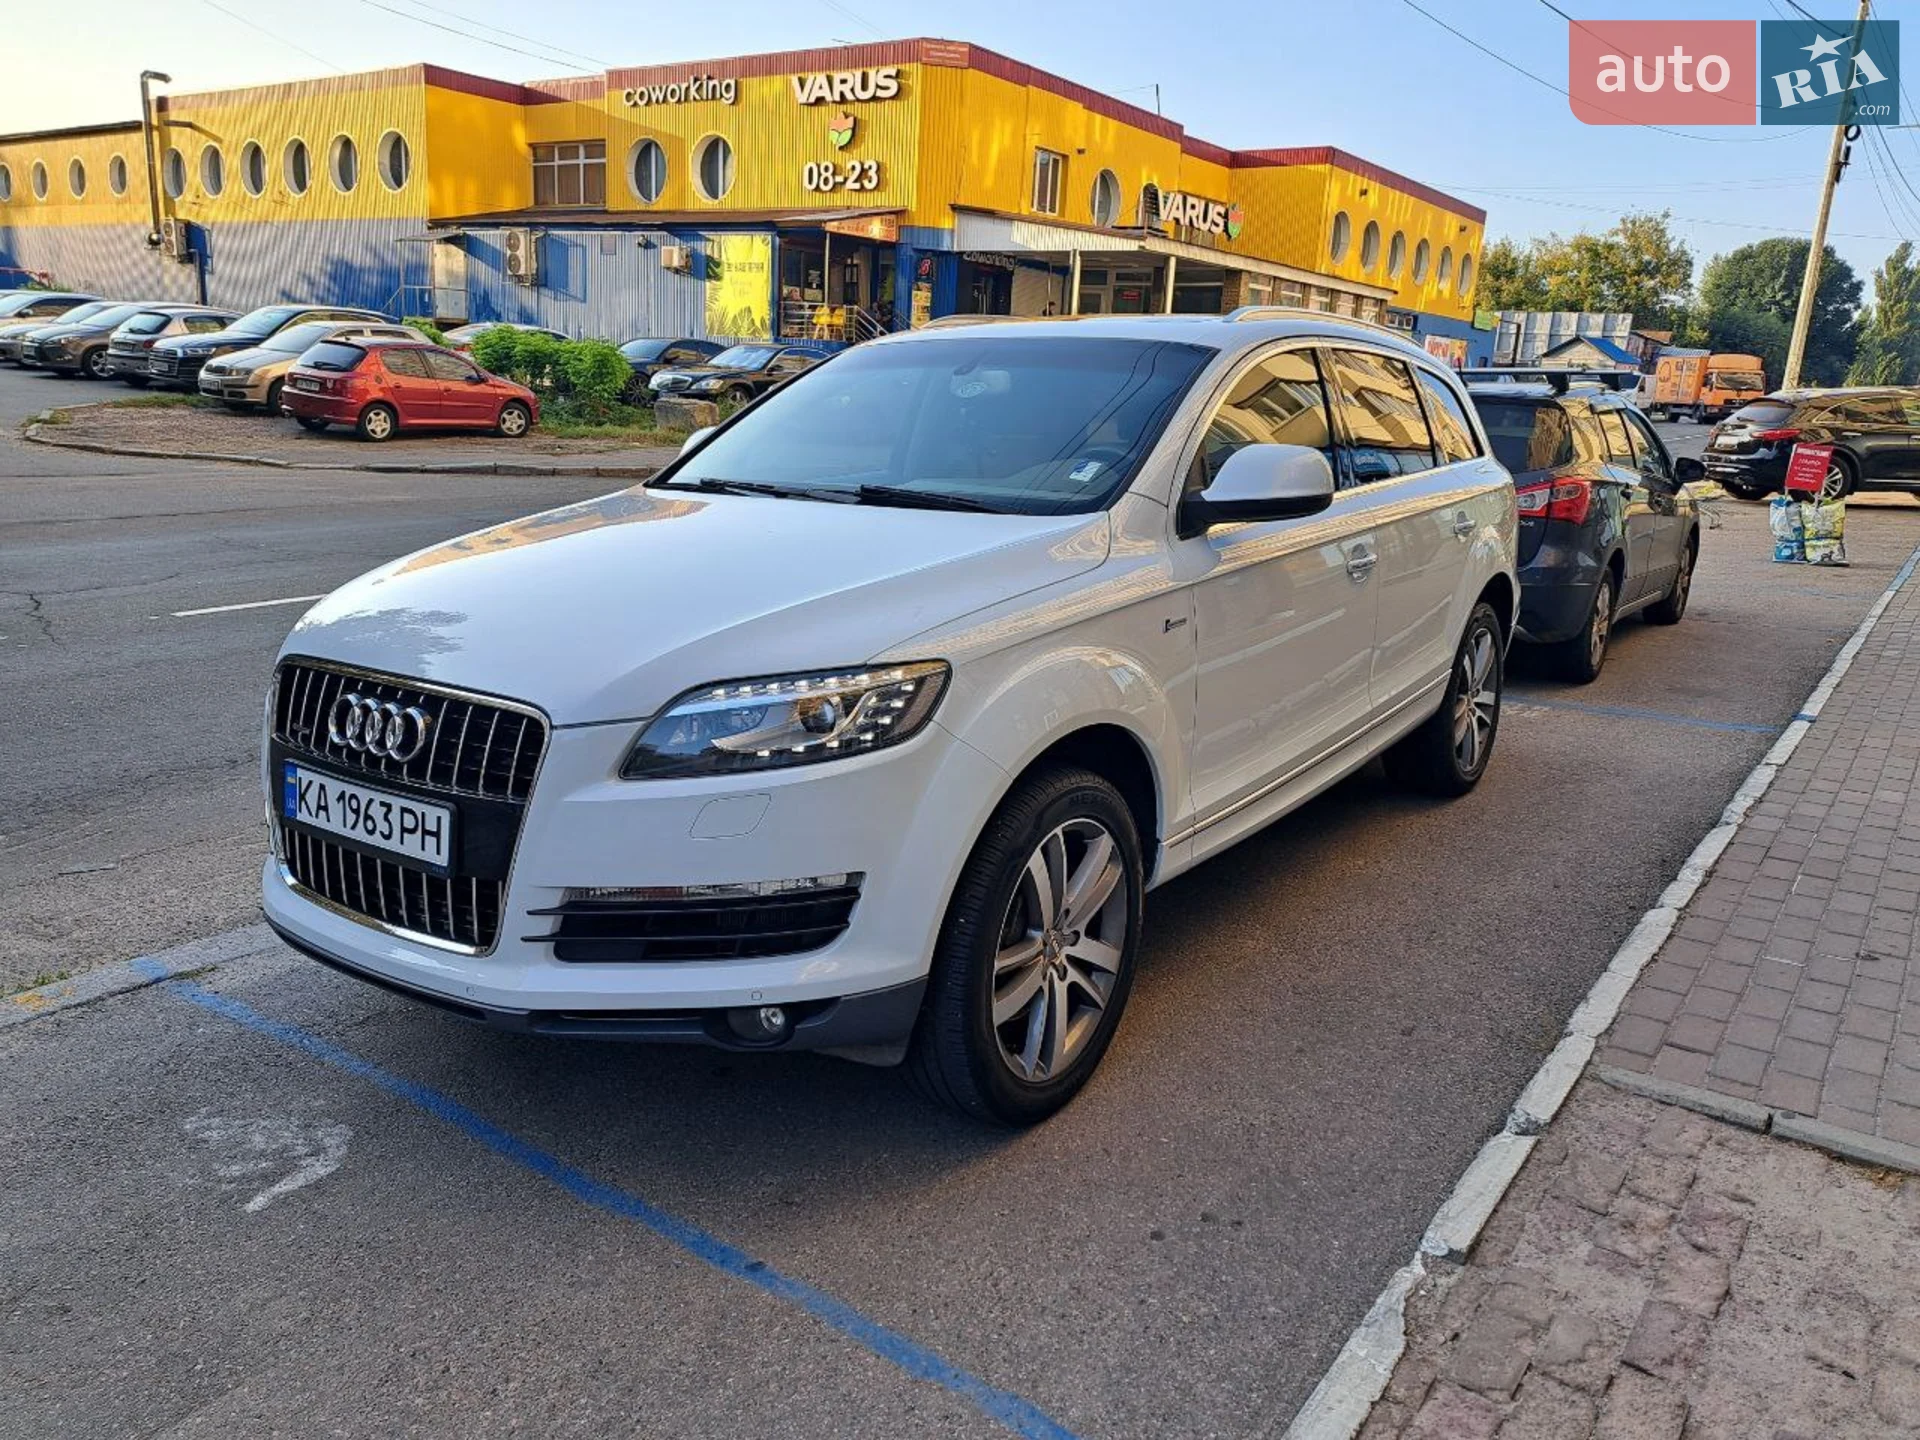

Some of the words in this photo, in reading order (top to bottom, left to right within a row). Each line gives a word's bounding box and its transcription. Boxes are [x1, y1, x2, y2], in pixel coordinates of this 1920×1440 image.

[623, 74, 736, 106] coworking
[791, 66, 899, 105] VARUS
[803, 159, 878, 191] 08-23
[1157, 191, 1227, 236] VARUS
